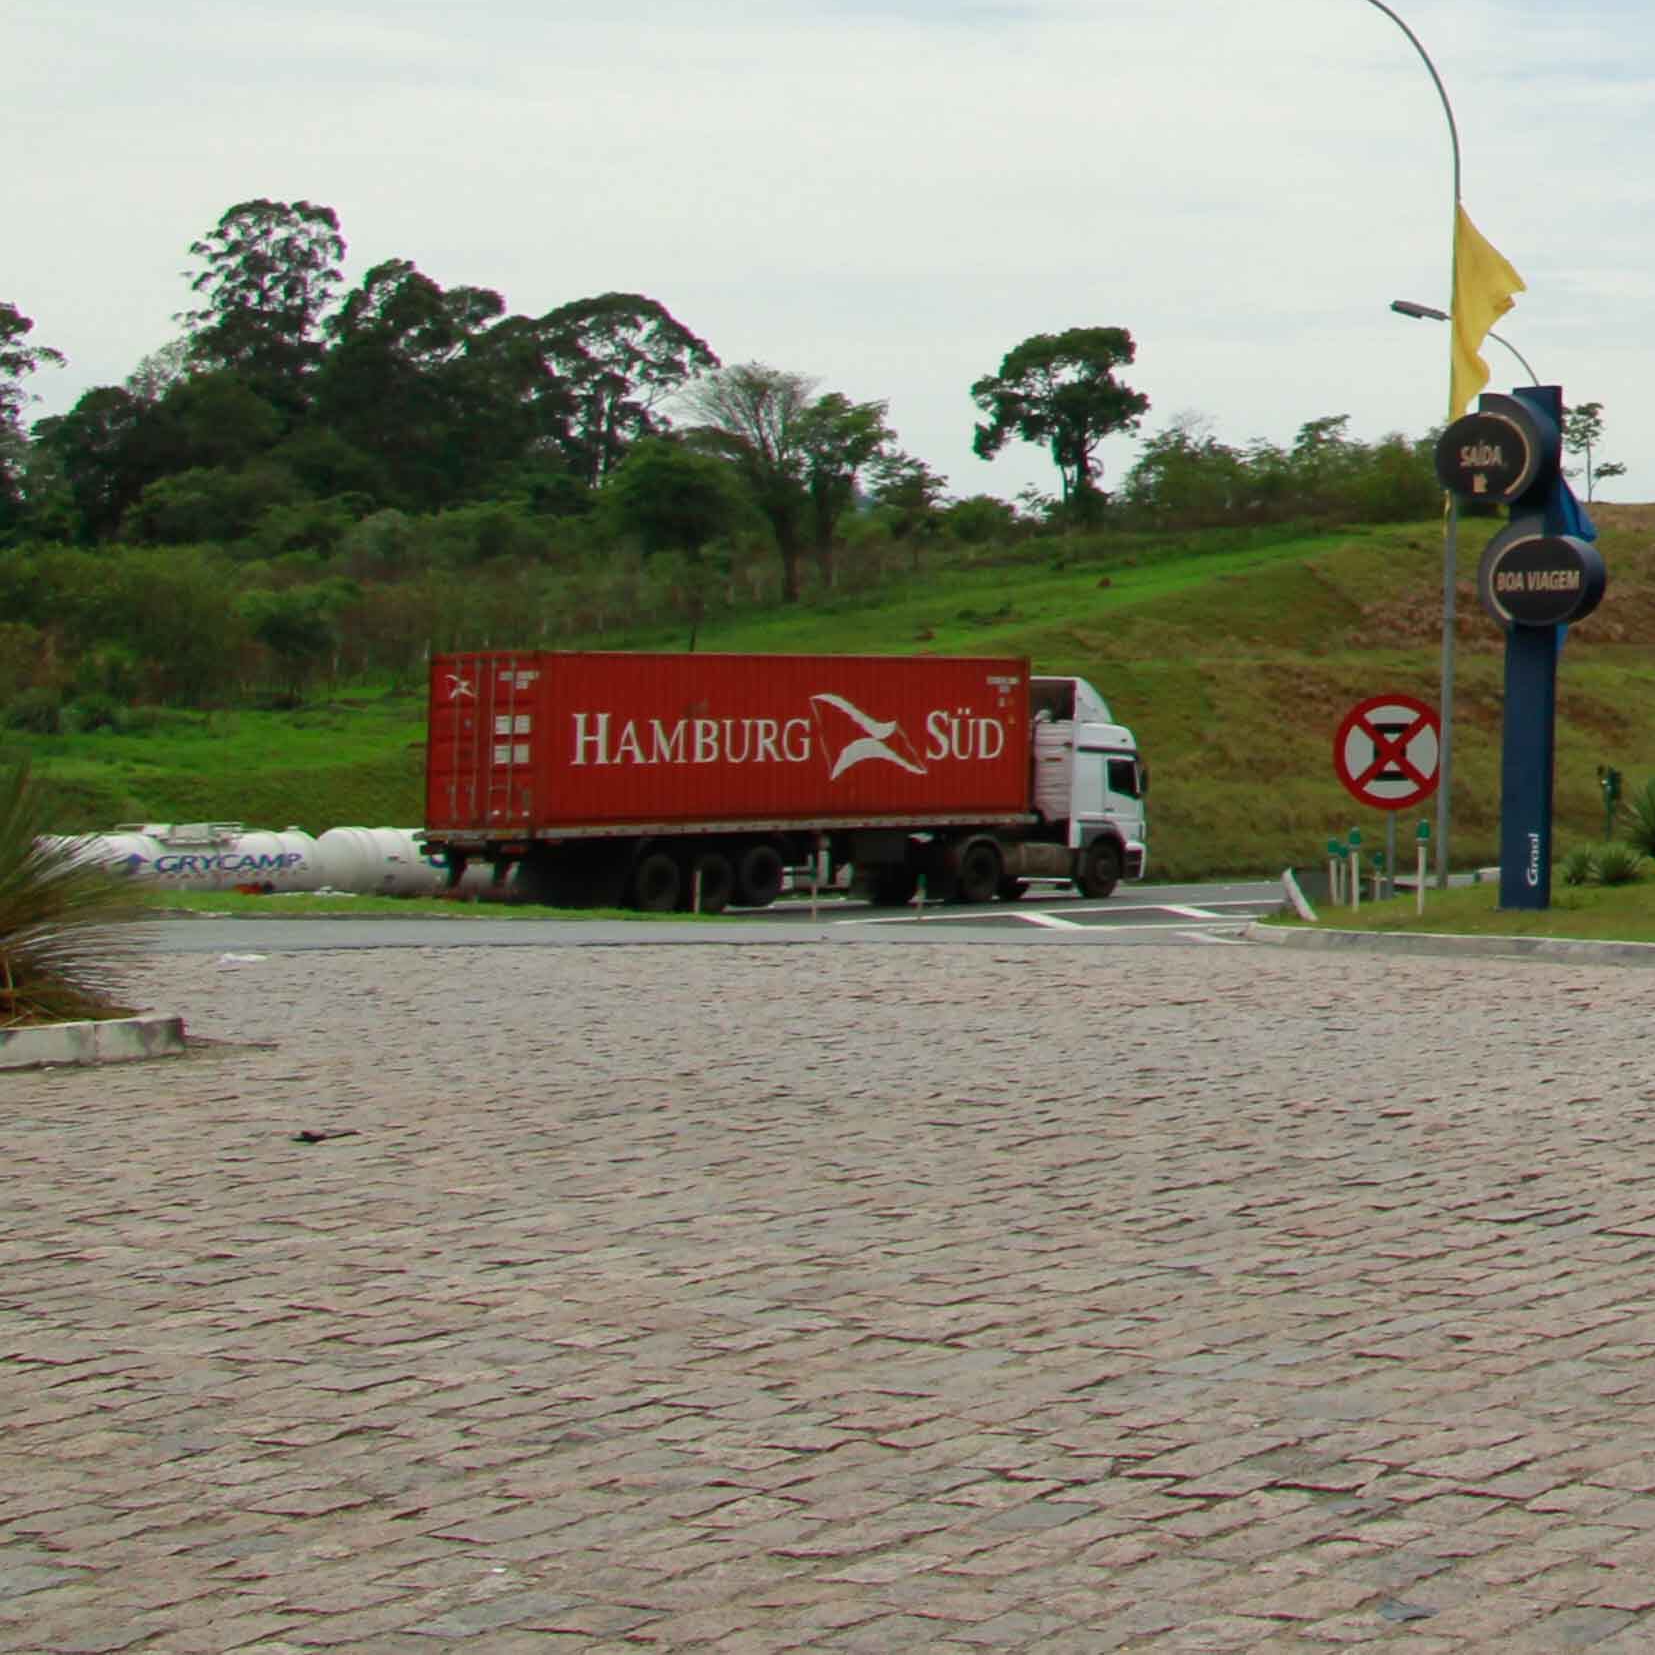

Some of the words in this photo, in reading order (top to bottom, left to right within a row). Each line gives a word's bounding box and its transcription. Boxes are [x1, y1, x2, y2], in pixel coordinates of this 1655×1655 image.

[1460, 439, 1502, 467] SAÍDA
[1496, 573, 1524, 592] BOA
[1527, 570, 1581, 590] VIAGEM
[570, 712, 811, 765] HAMBURG
[926, 708, 1004, 760] SÜD
[154, 853, 302, 872] GRYCAMP
[1526, 832, 1540, 886] Graal
